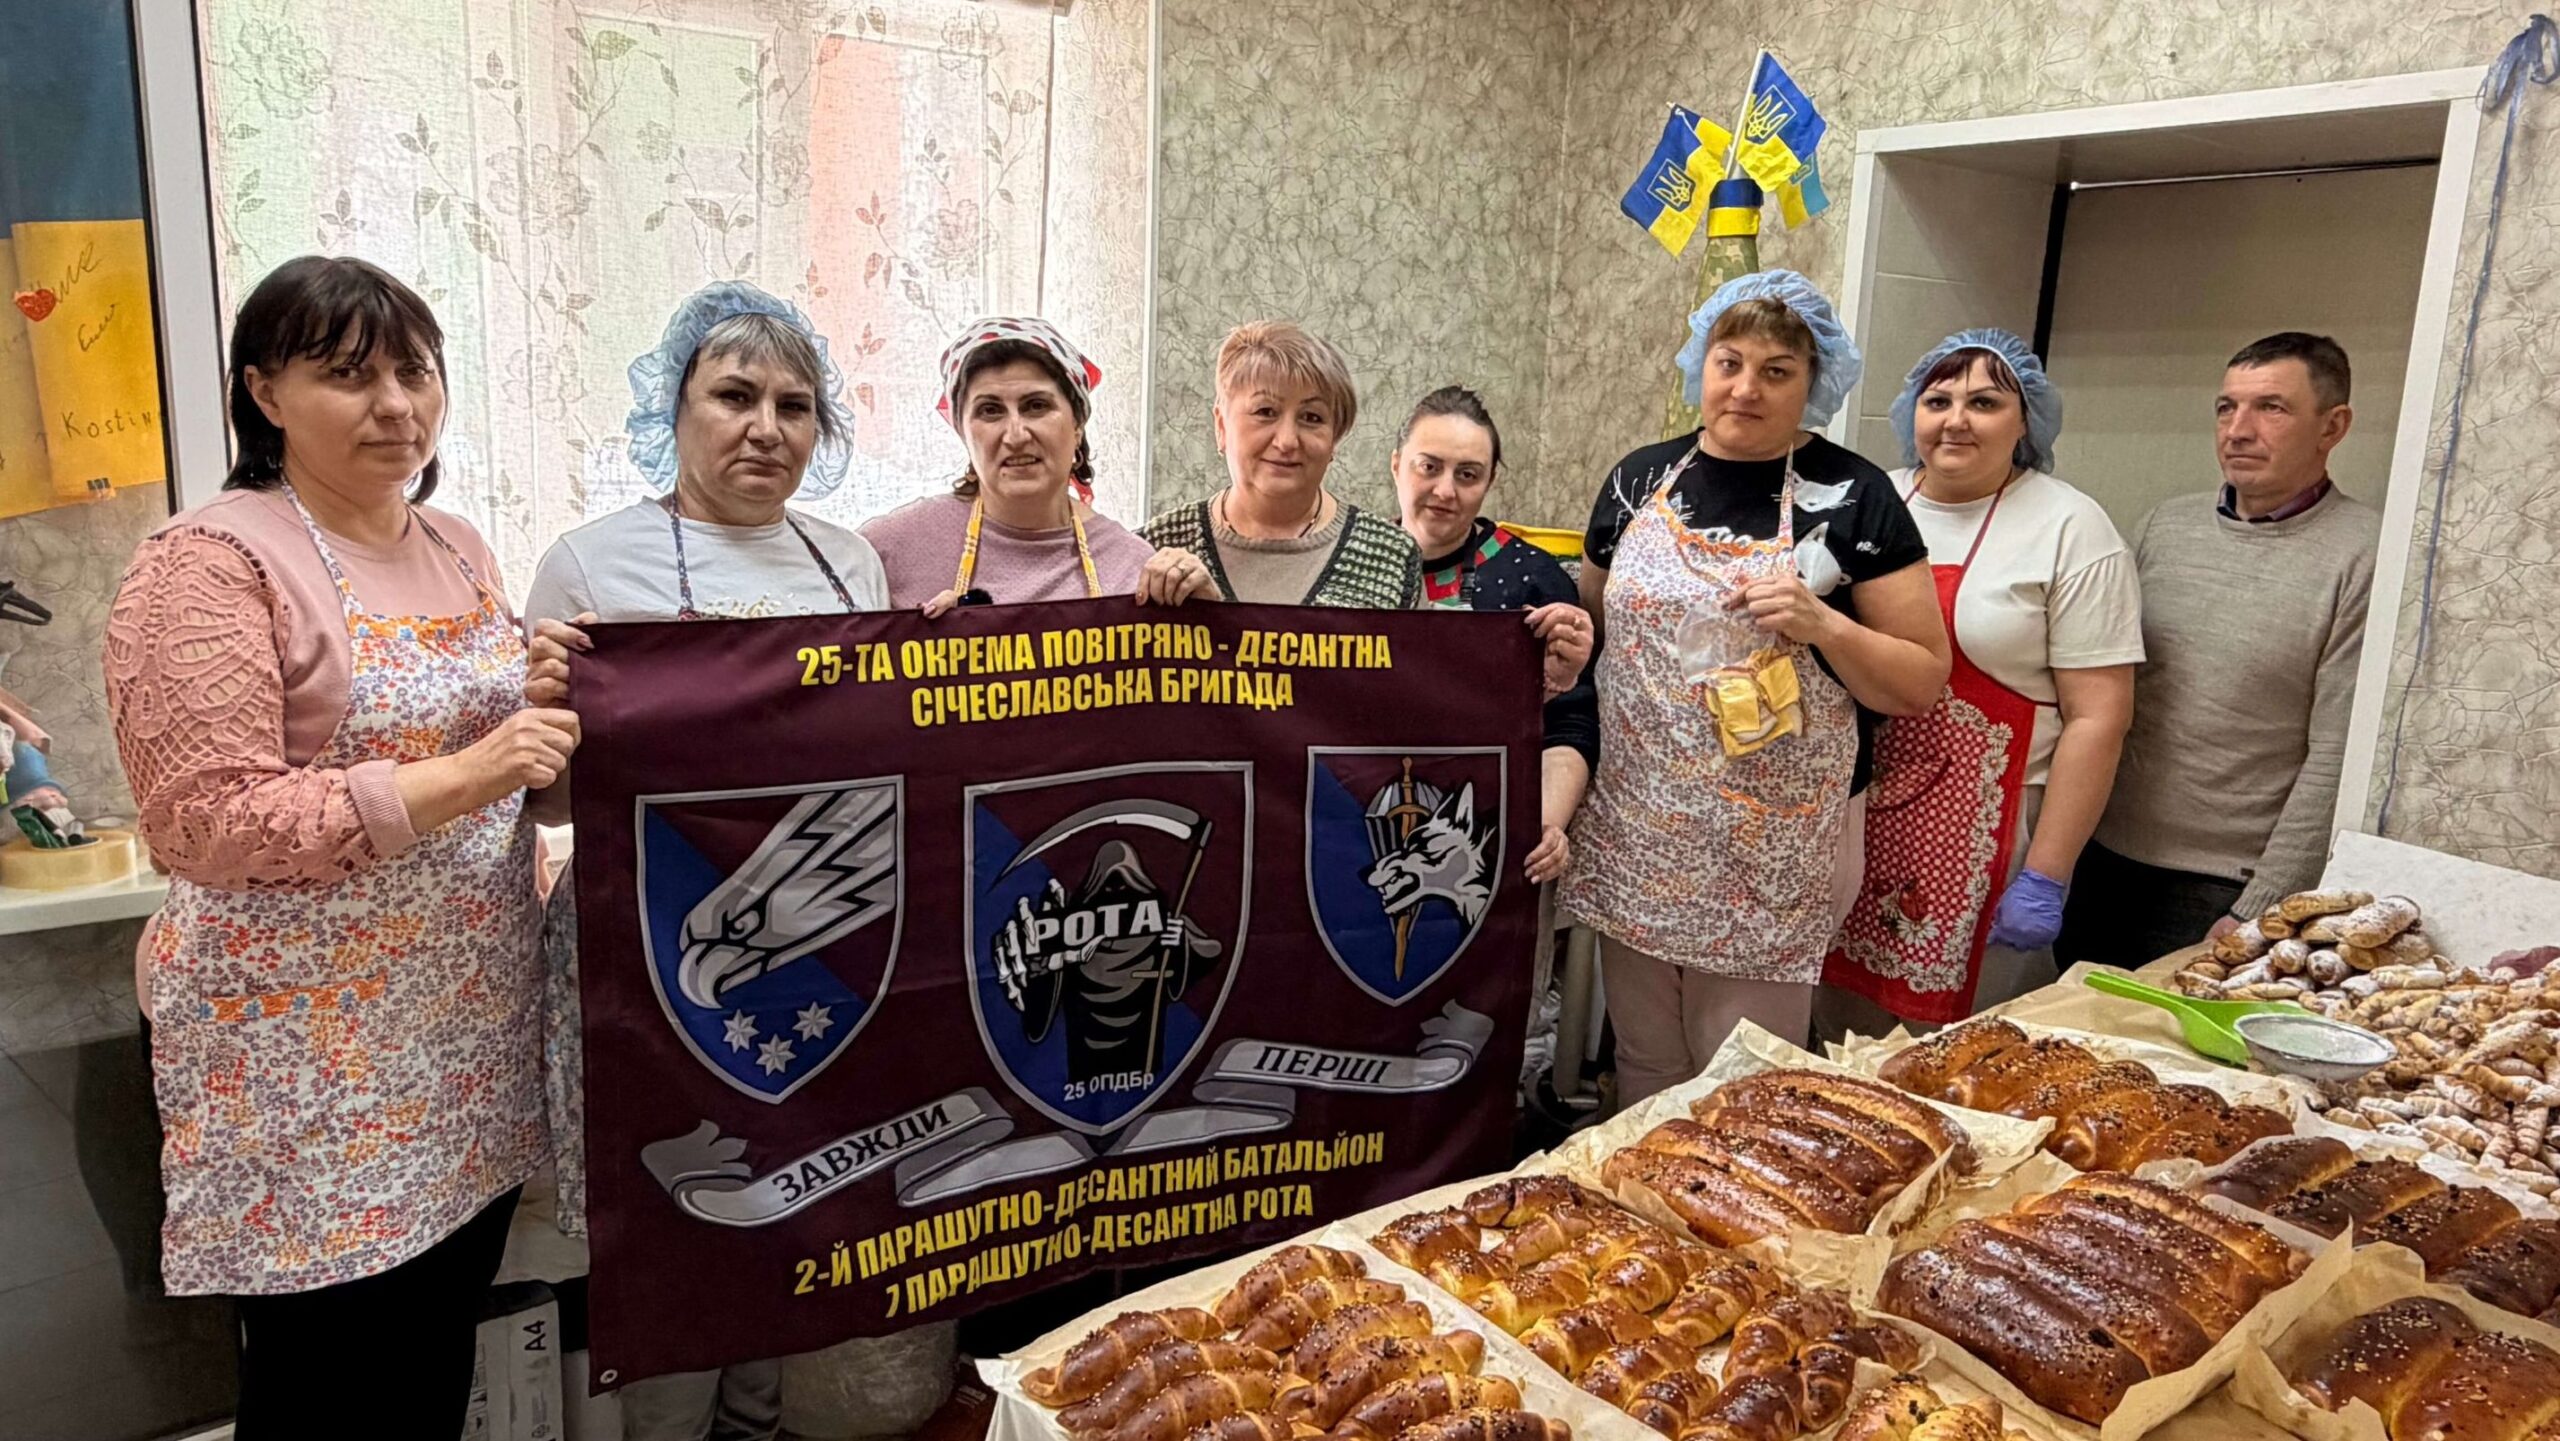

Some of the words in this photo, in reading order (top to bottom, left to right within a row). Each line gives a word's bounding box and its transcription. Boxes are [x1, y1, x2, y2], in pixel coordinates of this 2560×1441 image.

[796, 642, 895, 686] 25-ТА
[900, 633, 1036, 679] ОКРЕМА
[1042, 623, 1213, 668] ПОВІТРЯНО
[1235, 630, 1392, 668] ДЕСАНТНА
[911, 668, 1154, 727] СІЧЕСЛАВСЬКА
[1161, 668, 1294, 711] БРИГАДА
[1025, 900, 1163, 955] РОТА
[1063, 1081, 1086, 1101] 25
[1253, 1046, 1393, 1084] ПЕРШІ
[772, 1103, 952, 1203] ЗАВЖДИ
[794, 1240, 852, 1295] 2-Й
[856, 1147, 1219, 1279] ПАРАШУТНО-ДЕСАНТНИЙ
[1224, 1131, 1385, 1180] БАТАЛЬЙОН
[885, 1284, 900, 1319] 7
[906, 1192, 1237, 1313] ПАРАШУТНО-ДЕСАНТНА
[1243, 1184, 1314, 1222] РОТА
[523, 1320, 547, 1351] A4
